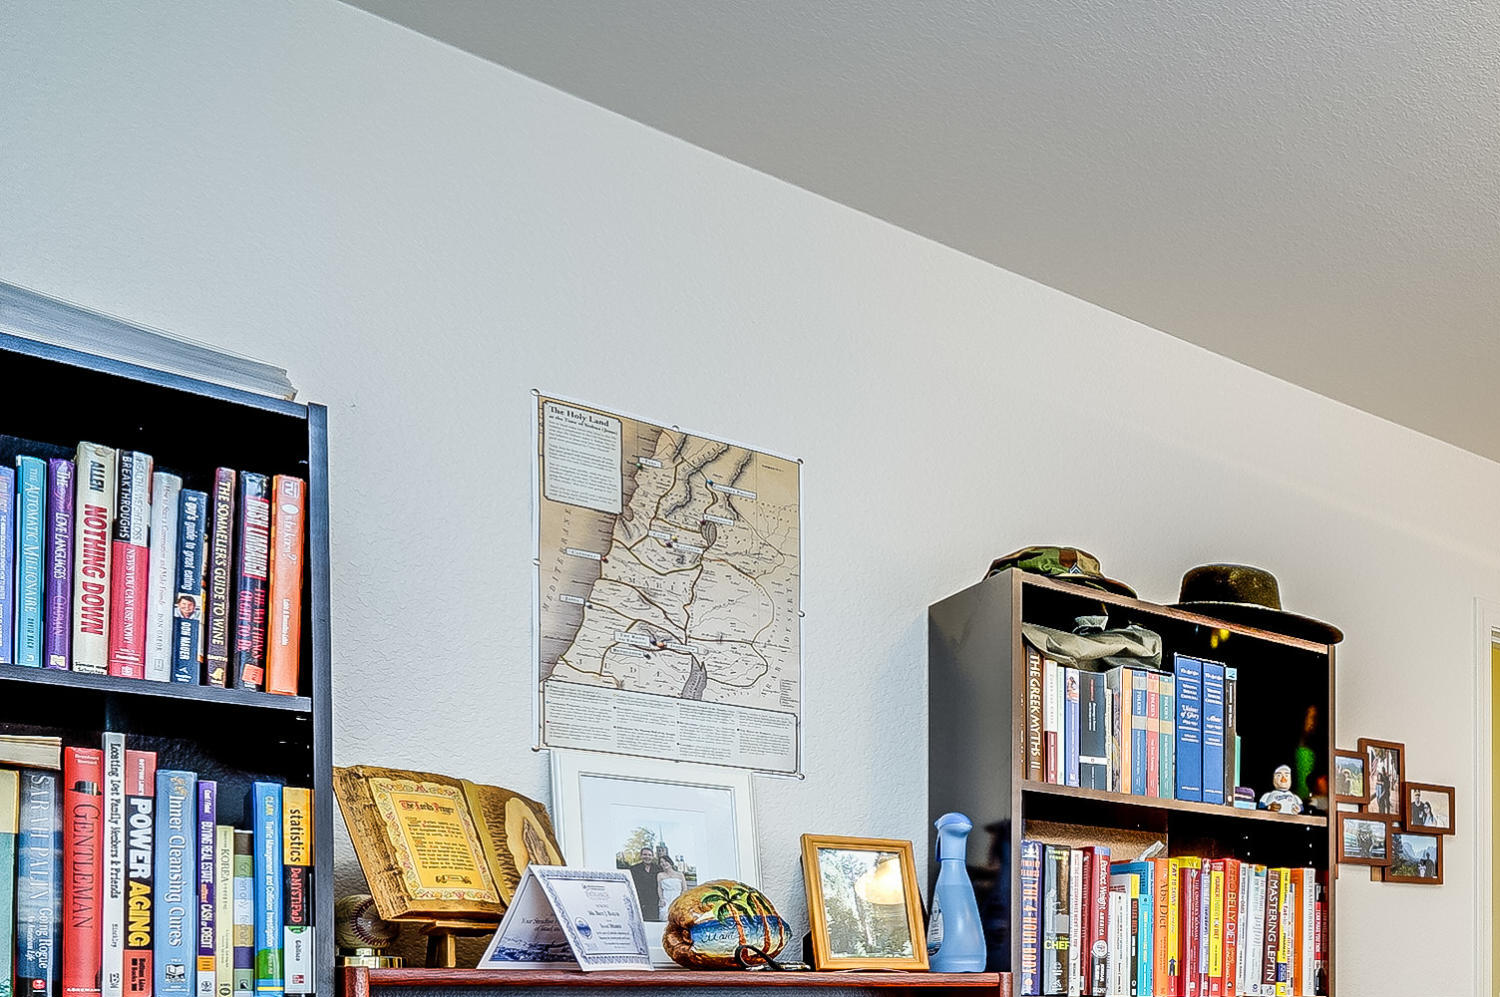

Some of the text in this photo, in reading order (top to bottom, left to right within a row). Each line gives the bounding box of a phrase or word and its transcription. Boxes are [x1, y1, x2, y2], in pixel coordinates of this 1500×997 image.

[549, 405, 610, 428] The Holy Land
[89, 461, 105, 492] ALLEN
[120, 456, 131, 538] BREAKTHROUGHS
[24, 482, 41, 541] AUTOMATIC
[214, 502, 230, 566] SOMMELIER'S
[244, 500, 268, 578] RUSH LIMBAUGH
[24, 544, 40, 613] MILLIONAIRE
[81, 504, 107, 635] NOTHING DOWN
[214, 568, 228, 600] GUIDE
[212, 619, 224, 645] WINE
[214, 603, 225, 616] TO
[1030, 679, 1040, 712] GREEK
[1030, 714, 1041, 756] MYTHS
[399, 799, 416, 811] The
[289, 809, 304, 862] statistics
[29, 847, 50, 901] PALIN
[72, 804, 101, 929] GENTLEMAN
[128, 798, 152, 947] POWER AGING
[165, 795, 187, 946] Inner Cleansing Cures
[35, 908, 54, 969] Going Rogue
[1266, 880, 1278, 981] MASTERING LEPTIN
